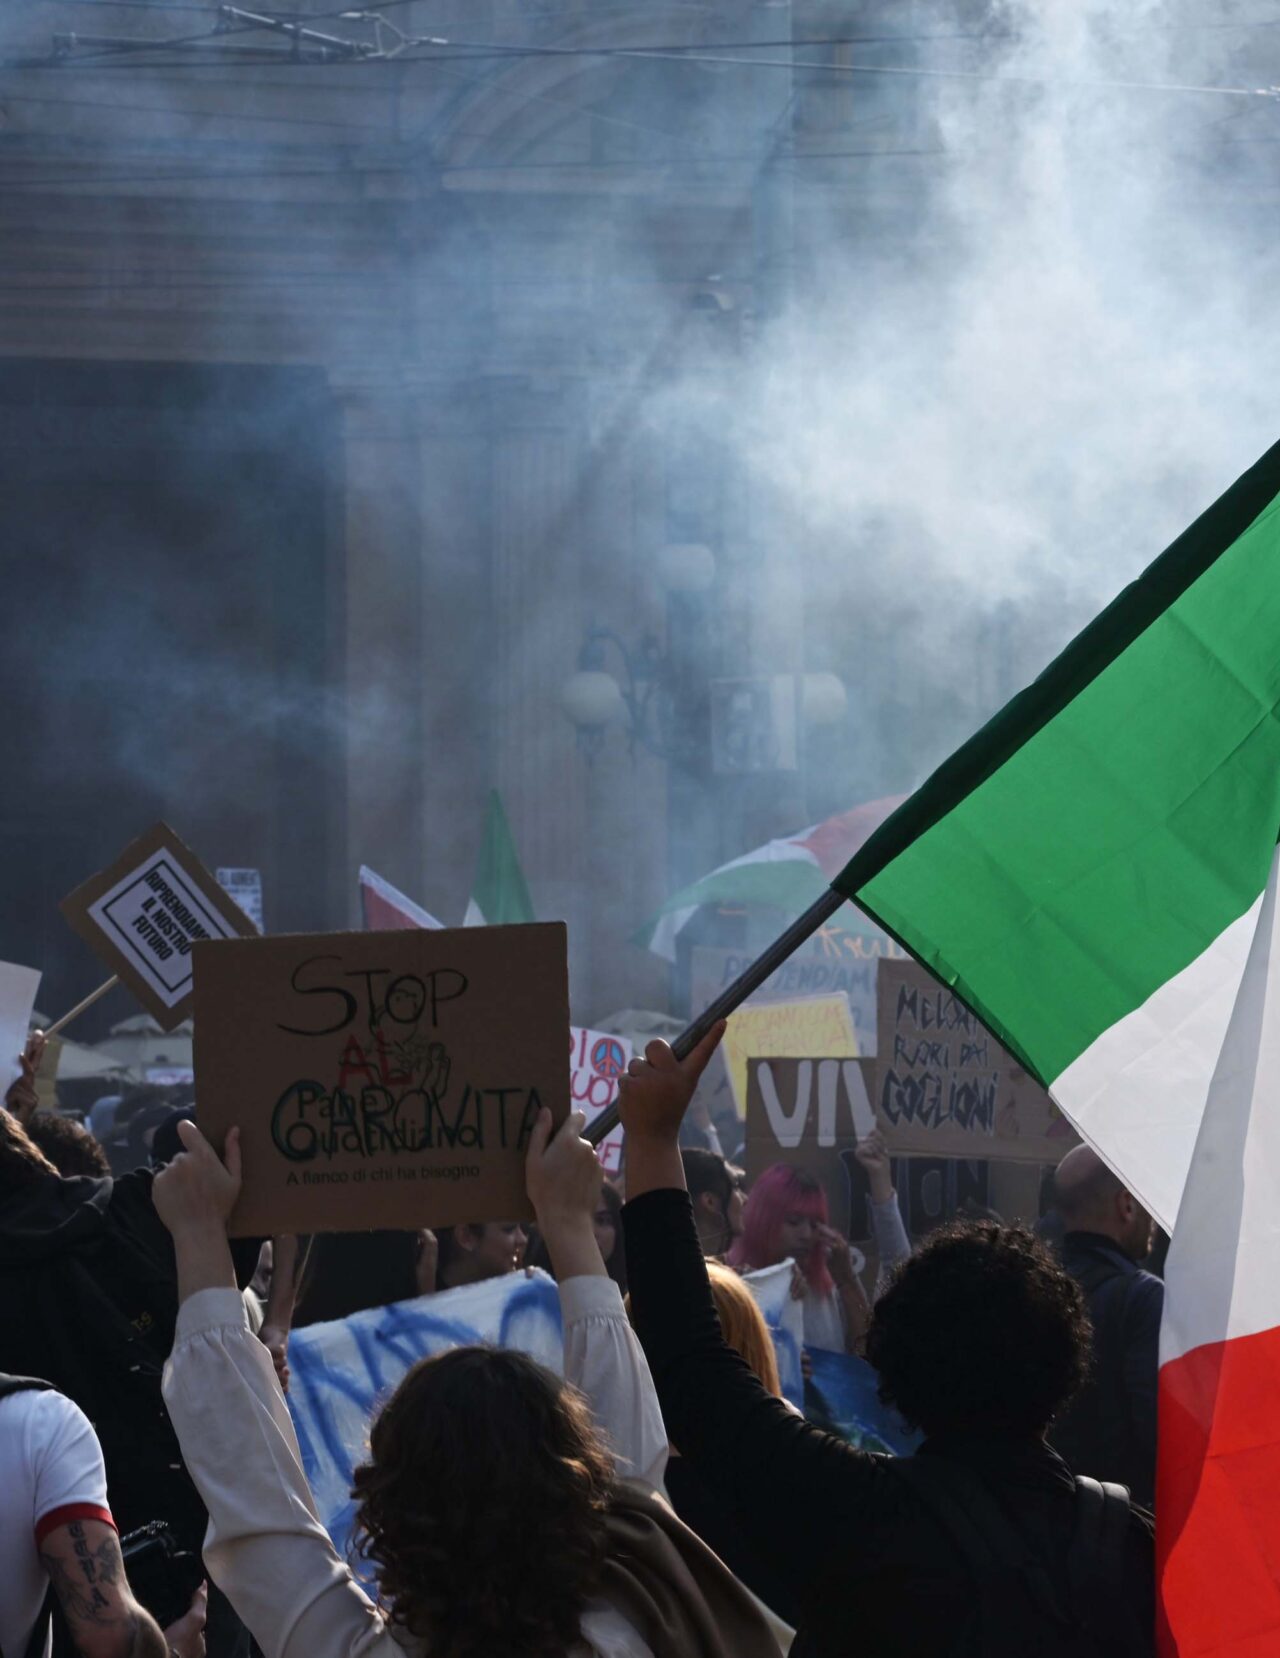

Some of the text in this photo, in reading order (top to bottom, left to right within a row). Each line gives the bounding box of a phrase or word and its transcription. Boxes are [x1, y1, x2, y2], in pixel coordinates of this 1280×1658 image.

[132, 915, 174, 961] FUTURO
[141, 897, 192, 956] IL NOSTRO
[277, 955, 468, 1036] STOP
[881, 1068, 998, 1133] COGLIONI
[287, 1163, 480, 1185] A fianco di chi ha bisogno
